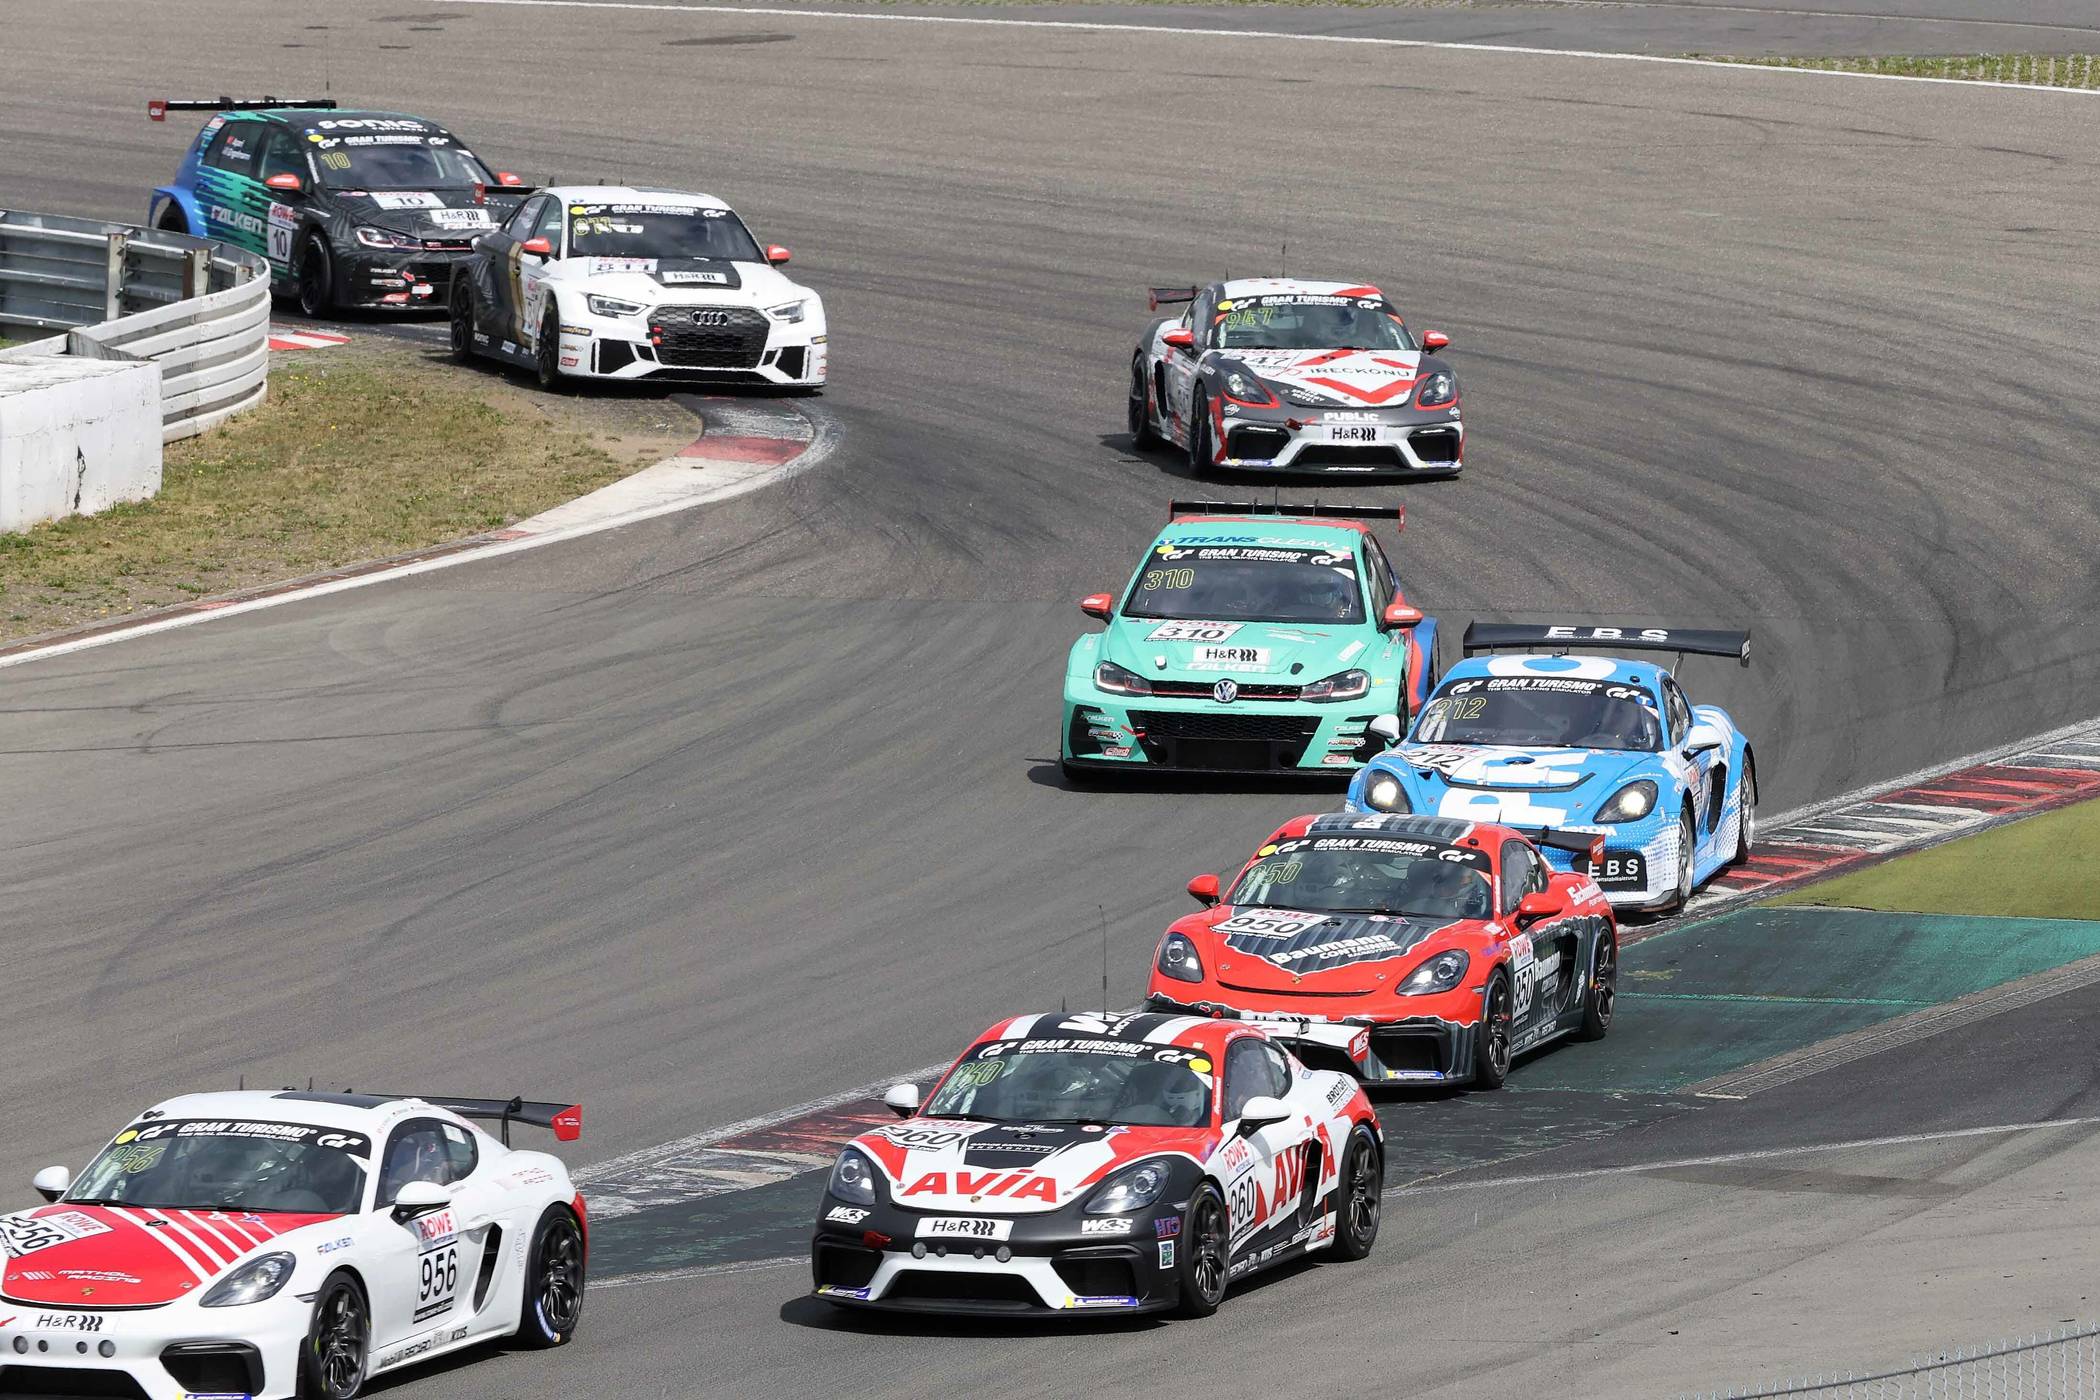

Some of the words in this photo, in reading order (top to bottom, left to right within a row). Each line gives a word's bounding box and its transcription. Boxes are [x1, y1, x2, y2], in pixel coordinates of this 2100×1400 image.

[344, 135, 373, 144] GRAN
[321, 152, 352, 170] 10
[611, 204, 643, 212] GRAN
[210, 204, 263, 235] FALKEN
[273, 228, 288, 258] 10
[1260, 295, 1294, 304] GRAN
[1310, 367, 1410, 377] IRECKONU
[1323, 412, 1379, 422] PUBLIC
[1332, 427, 1359, 440] H&R
[1198, 547, 1240, 558] GRAN
[1144, 568, 1195, 591] 310
[1157, 627, 1226, 640] 310
[1206, 648, 1238, 660] H&R
[1487, 677, 1529, 688] GRAN
[1434, 697, 1487, 721] 212
[1408, 751, 1464, 768] 212
[1314, 838, 1355, 849] GRAN
[1255, 911, 1319, 921] ROWE
[1226, 915, 1305, 934] 950
[1269, 933, 1392, 965] Baumann
[1319, 940, 1397, 960] CONTAINER
[1514, 938, 1532, 958] ROWE
[1513, 967, 1534, 1013] 950
[1020, 1039, 1069, 1051] GRAN
[1091, 1050, 1138, 1058] SIMULATOR
[178, 1122, 226, 1134] GRAN
[916, 1120, 981, 1131] ROWE
[252, 1133, 300, 1142] SIMULATOR
[1223, 1139, 1249, 1171] ROWE
[1229, 1175, 1255, 1236] 960
[61, 1213, 104, 1232] ROWE
[418, 1212, 453, 1242] ROWE
[932, 1219, 969, 1233] H&R
[1081, 1217, 1133, 1232] W&S
[10, 1216, 65, 1250] 956
[316, 1237, 355, 1256] FALKEN
[57, 1269, 134, 1278] MATHOL
[66, 1275, 144, 1285] RACING
[420, 1247, 457, 1302] 956
[36, 1313, 77, 1328] H&R
